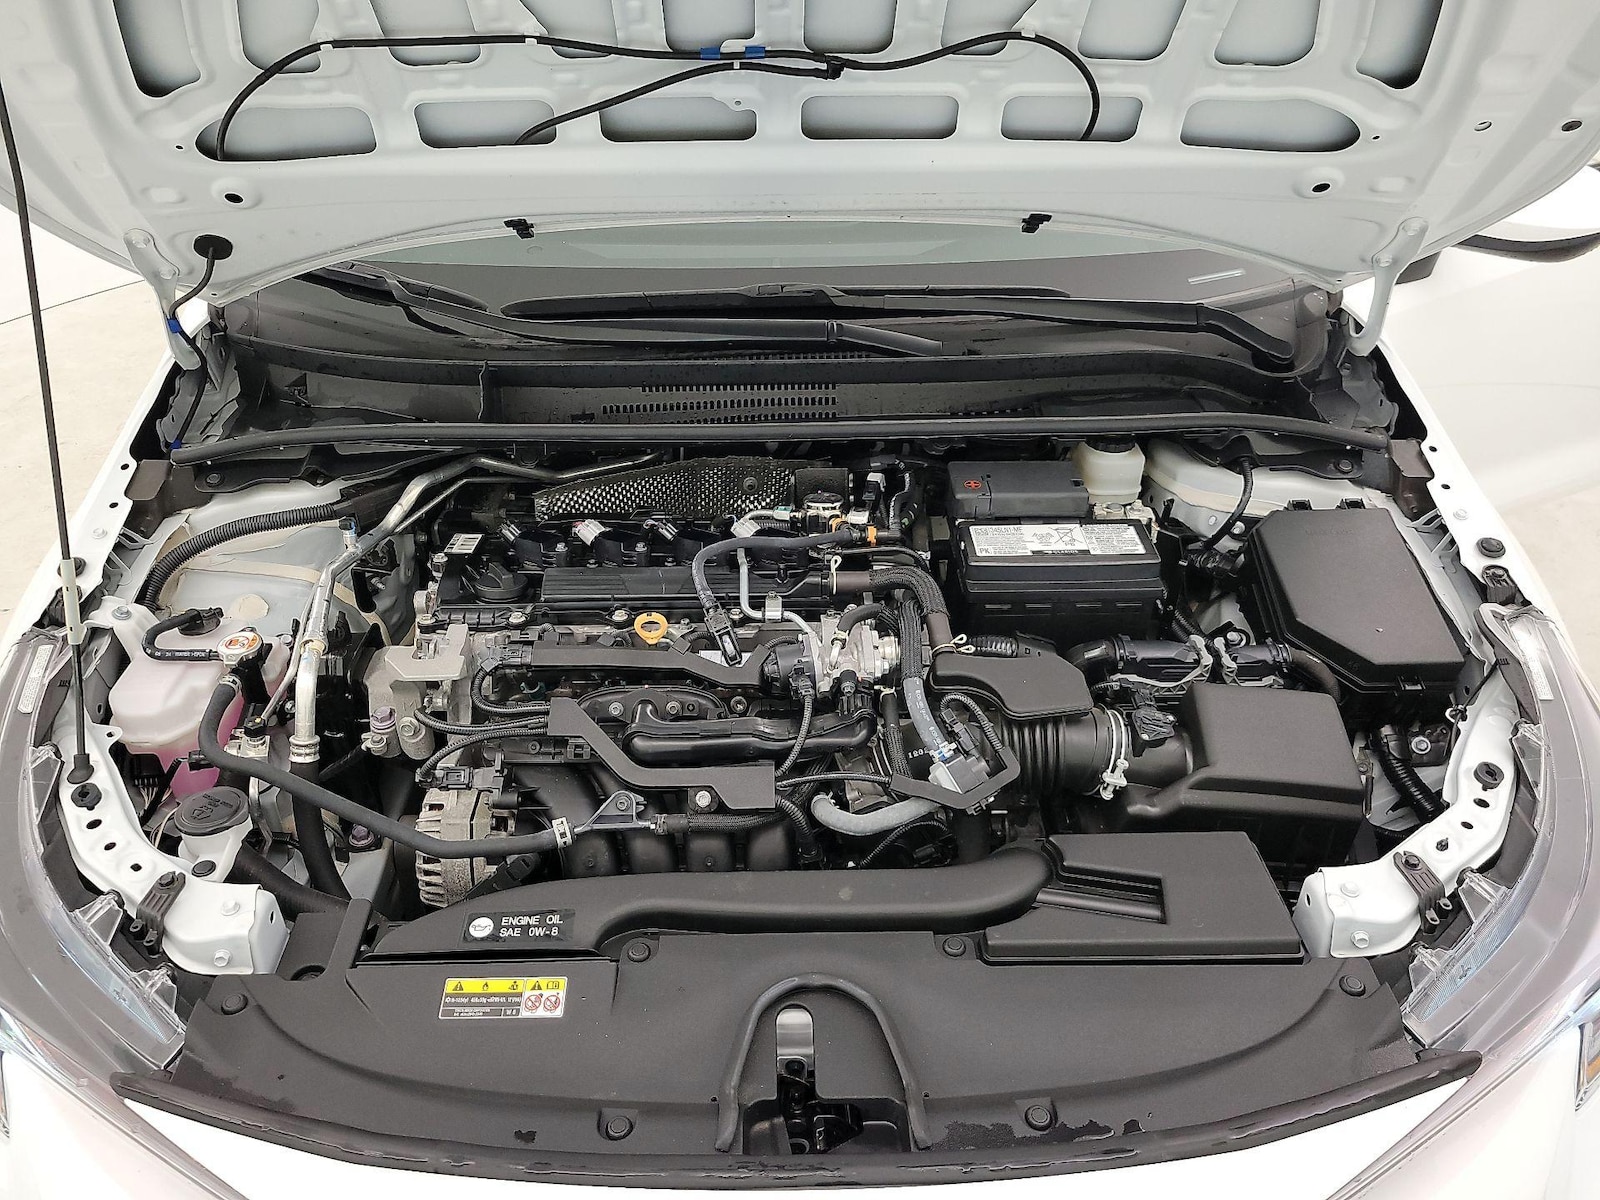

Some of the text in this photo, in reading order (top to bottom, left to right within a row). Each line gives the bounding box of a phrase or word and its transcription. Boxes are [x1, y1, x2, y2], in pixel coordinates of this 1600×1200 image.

[501, 915, 563, 926] ENGINE OIL
[499, 926, 558, 937] SAE 0W-8
